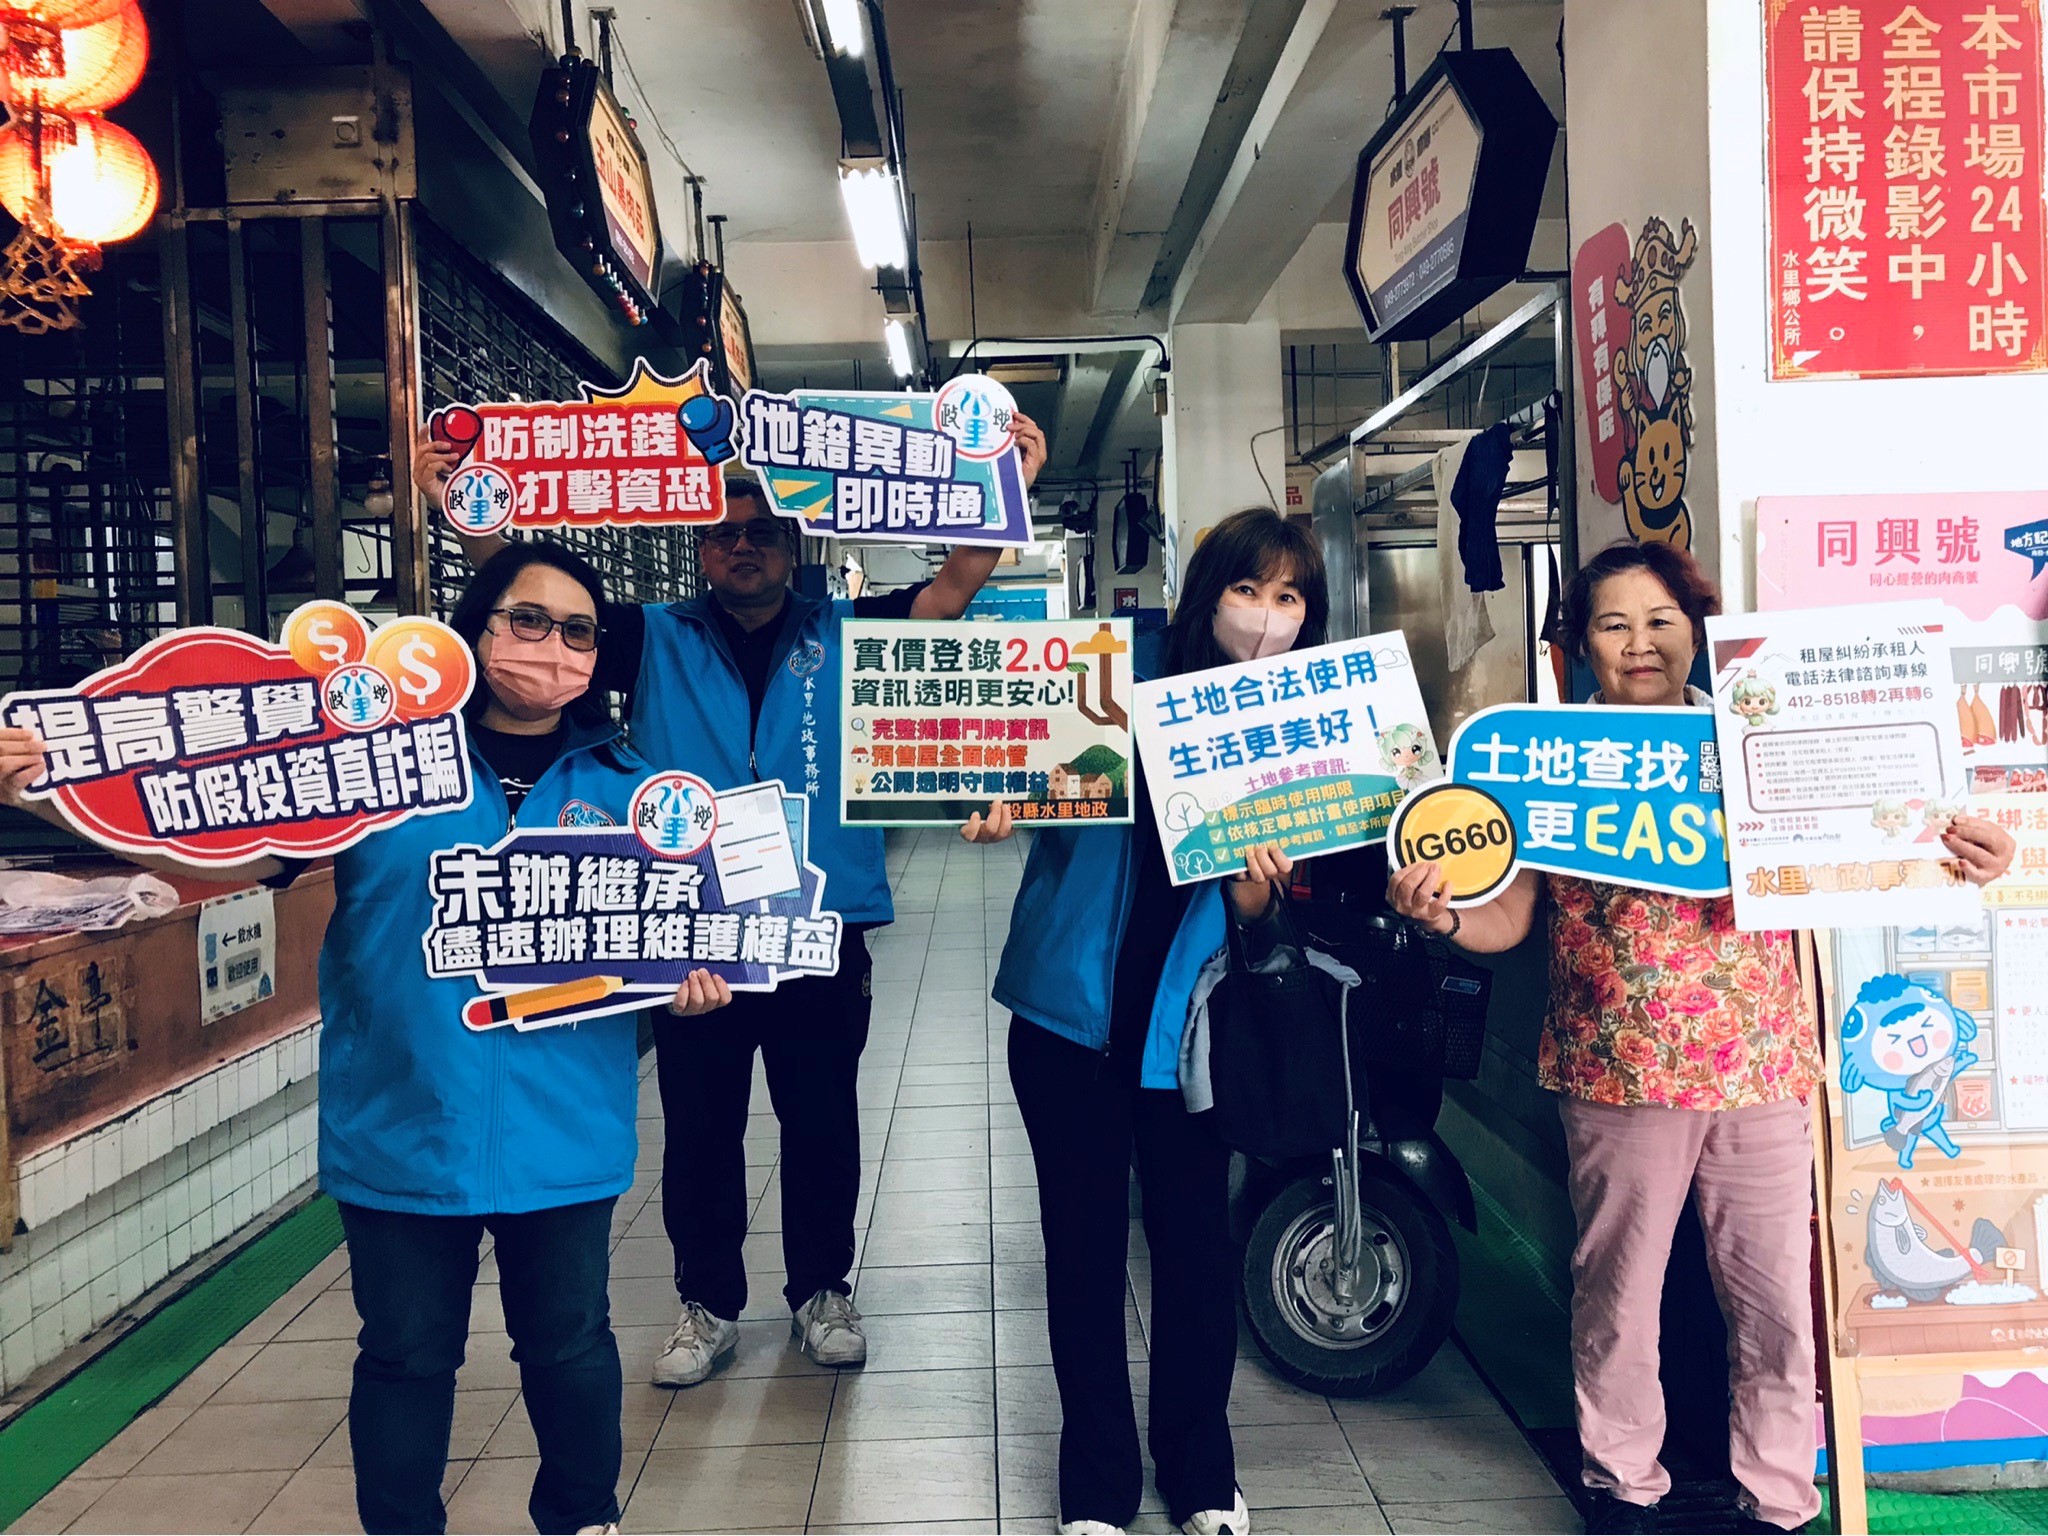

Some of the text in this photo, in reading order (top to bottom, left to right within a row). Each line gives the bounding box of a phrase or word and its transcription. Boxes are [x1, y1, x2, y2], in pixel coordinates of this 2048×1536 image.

[1800, 6, 1868, 342] 請保持微笑。
[1960, 4, 2029, 357] 本市場24小時
[1387, 155, 1441, 250] 同興號
[1781, 250, 1801, 346] 水里鄉公所
[483, 411, 679, 461] 防制洗錢
[750, 398, 953, 479] 地籍異動
[517, 466, 712, 516] 打擊資恐
[836, 476, 982, 530] 即時通
[1817, 516, 1982, 567] 同興號
[1869, 571, 1979, 587] 同心經營的肉商號
[852, 636, 1070, 674] 實價登錄2.0
[1784, 662, 1929, 688] 電話法律諮詢專線
[1800, 639, 1926, 664] 租屋糾紛承租人
[1975, 648, 2048, 677] 同興號
[851, 678, 1074, 708] 資訊透明更安心!
[1155, 650, 1379, 728] 土地合法使用
[1787, 685, 1934, 709] 412-8518轉2再轉6
[9, 682, 321, 787] 提高警覺
[801, 676, 821, 798] 水里地政事務所
[872, 717, 1051, 741] 完整揭露門牌資訊
[140, 719, 462, 834] 防假投資真詐騙
[871, 745, 1029, 768] 預售屋全面納管
[1467, 732, 1690, 793] 土地查找
[870, 771, 1050, 794] 公開透明守護權益
[1222, 780, 1354, 823] 標示臨時使用期限
[989, 801, 1109, 819] 投縣水里地政
[1403, 818, 1508, 865] IG660
[439, 852, 706, 925] 未辦繼承
[238, 922, 262, 945] 飲水機
[430, 912, 837, 972] 儘速辦理維護權益
